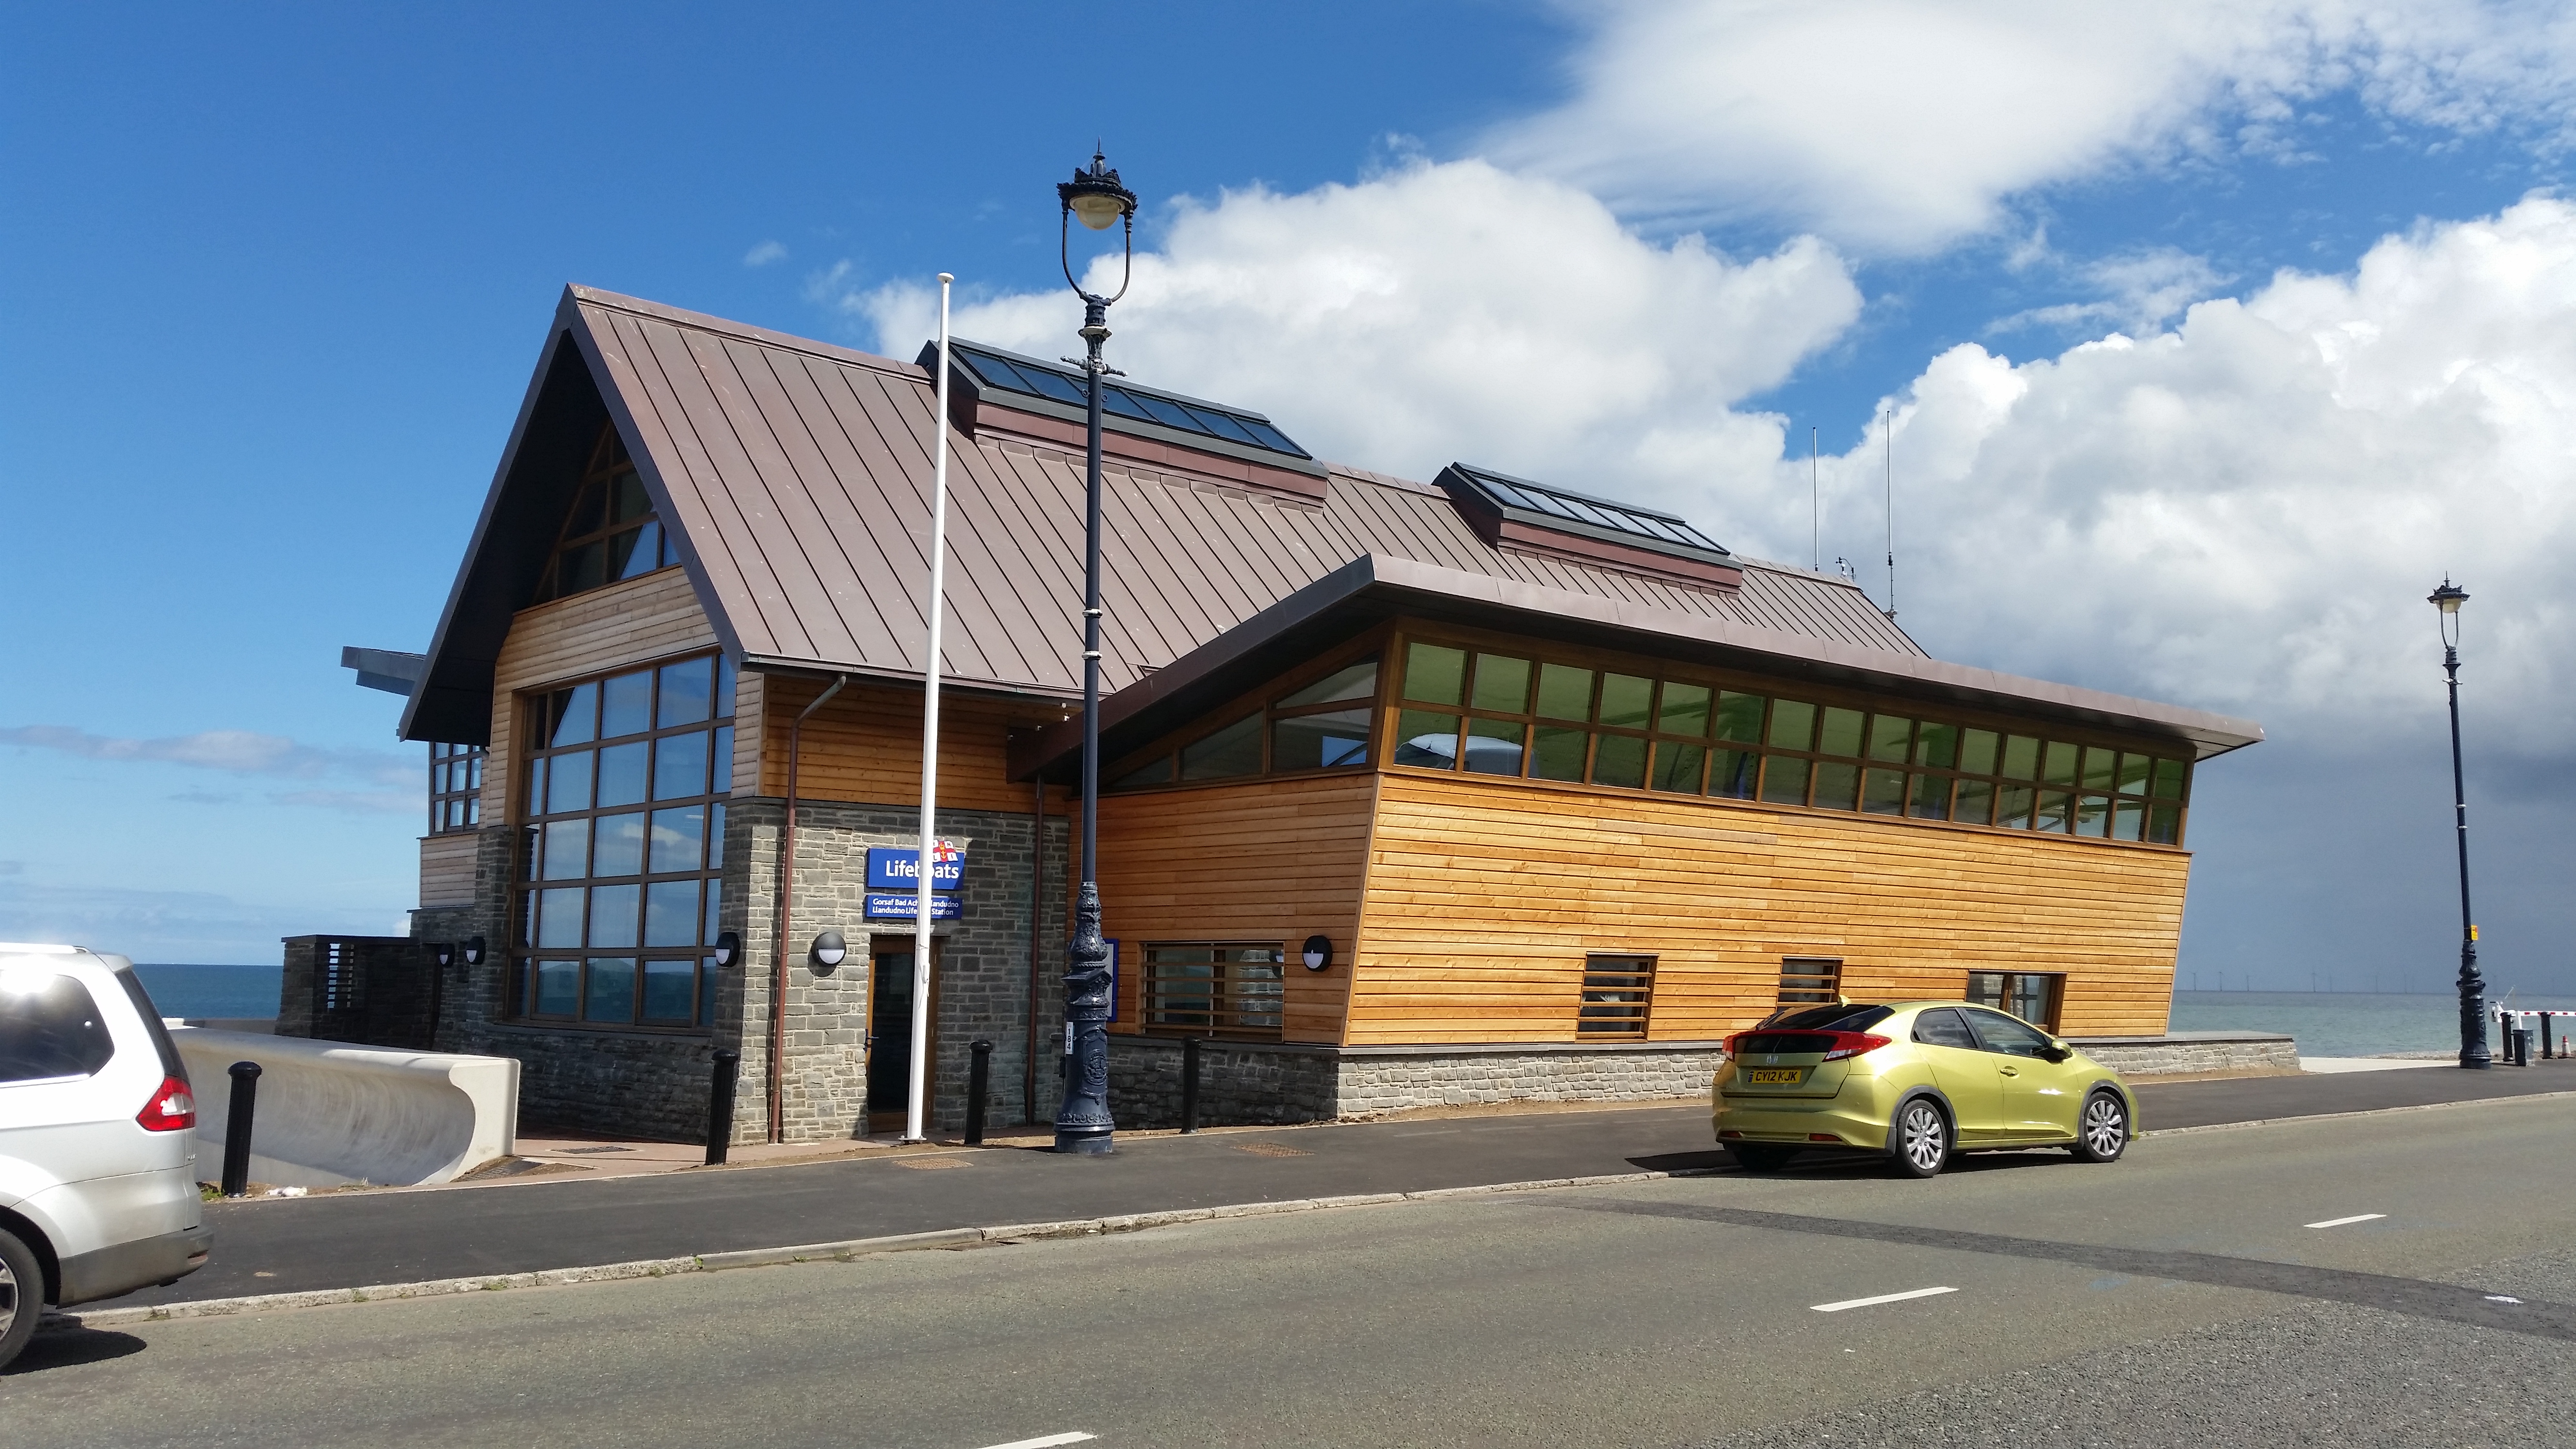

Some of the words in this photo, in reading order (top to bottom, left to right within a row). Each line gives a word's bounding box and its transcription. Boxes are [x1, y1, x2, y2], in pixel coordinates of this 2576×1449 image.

[886, 860, 959, 879] Lifeats
[872, 906, 905, 914] Llandudno
[1755, 1071, 1777, 1081] CY12
[1778, 1071, 1798, 1081] KJK
